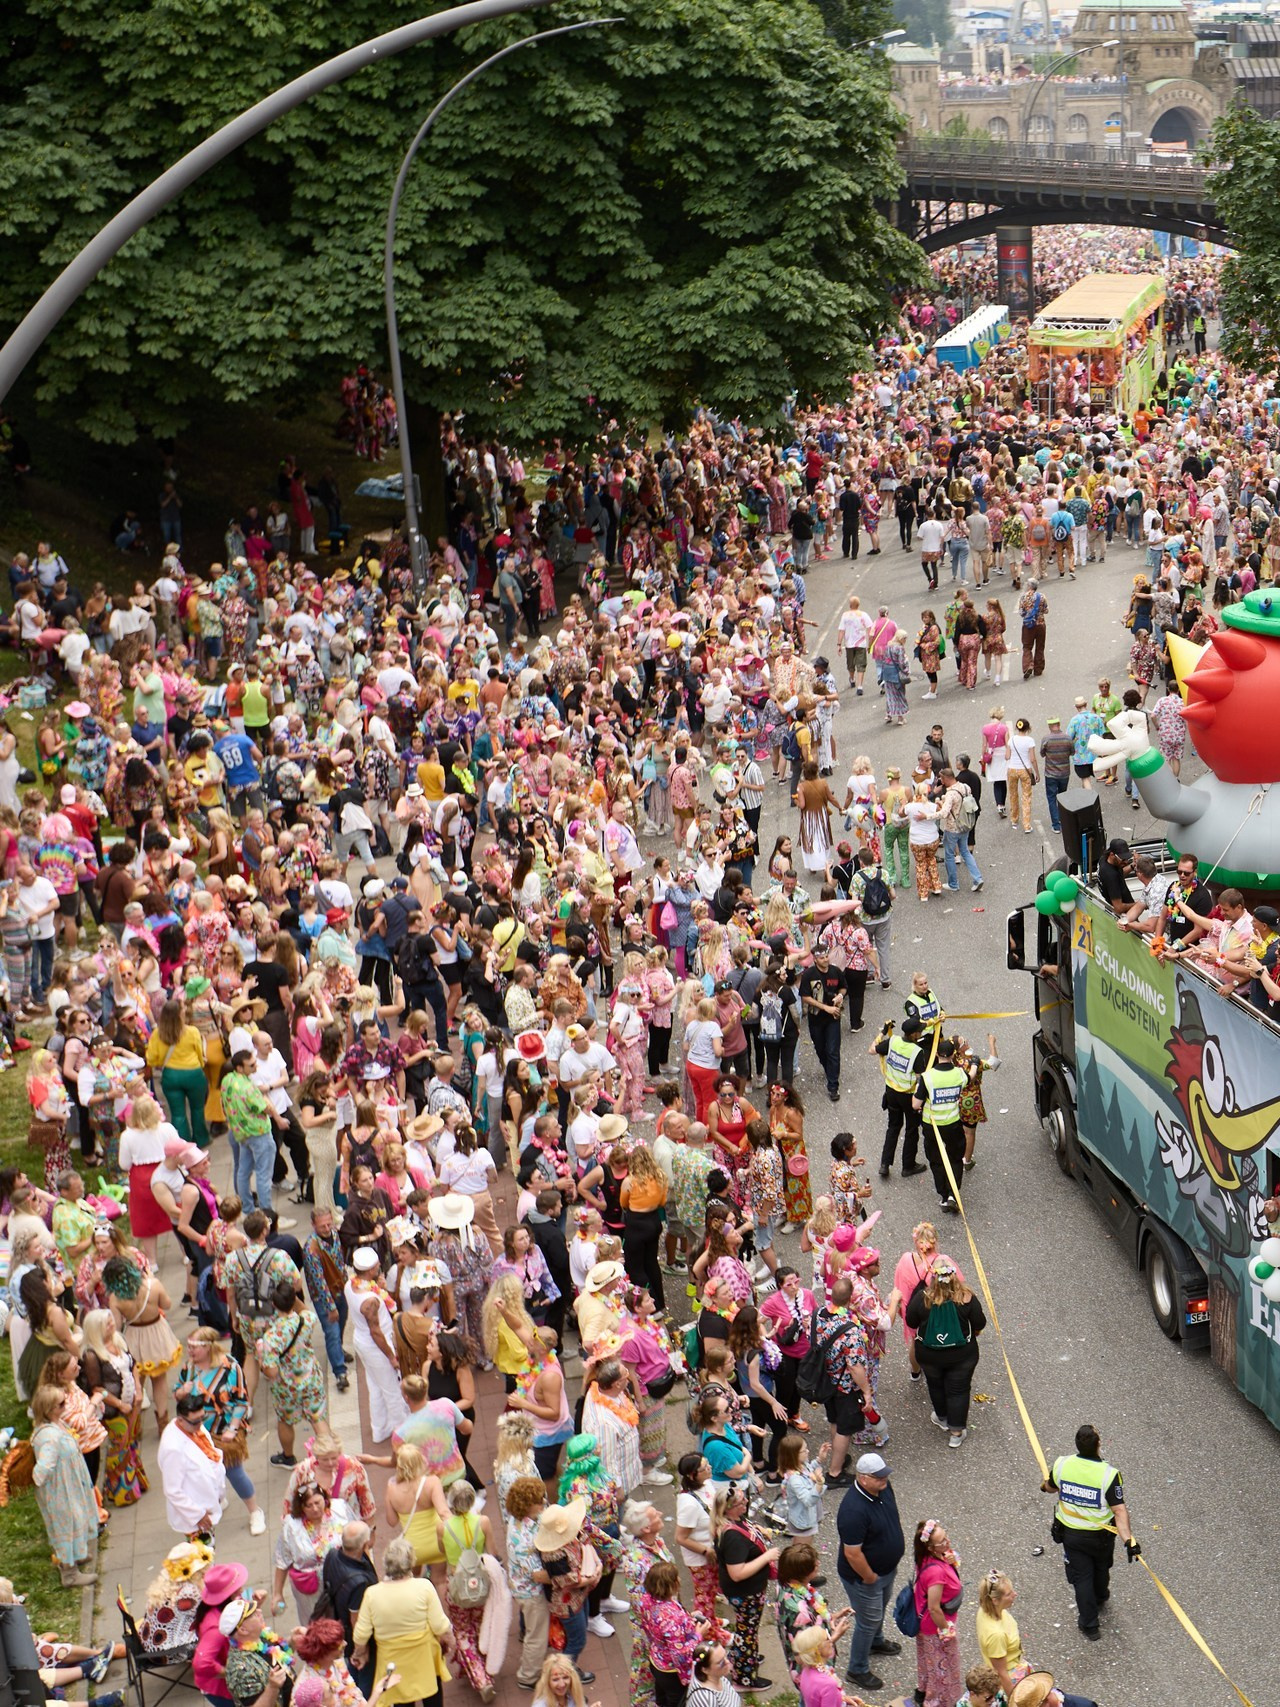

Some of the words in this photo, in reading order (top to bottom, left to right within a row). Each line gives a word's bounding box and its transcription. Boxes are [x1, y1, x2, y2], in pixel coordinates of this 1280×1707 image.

[1092, 393, 1103, 401] 20
[223, 747, 243, 769] 89
[1077, 925, 1092, 953] 21
[1094, 945, 1167, 1016] SCHLADMING
[1101, 977, 1160, 1041] DACHSTEIN
[1062, 1483, 1098, 1500] SICHERHEIT
